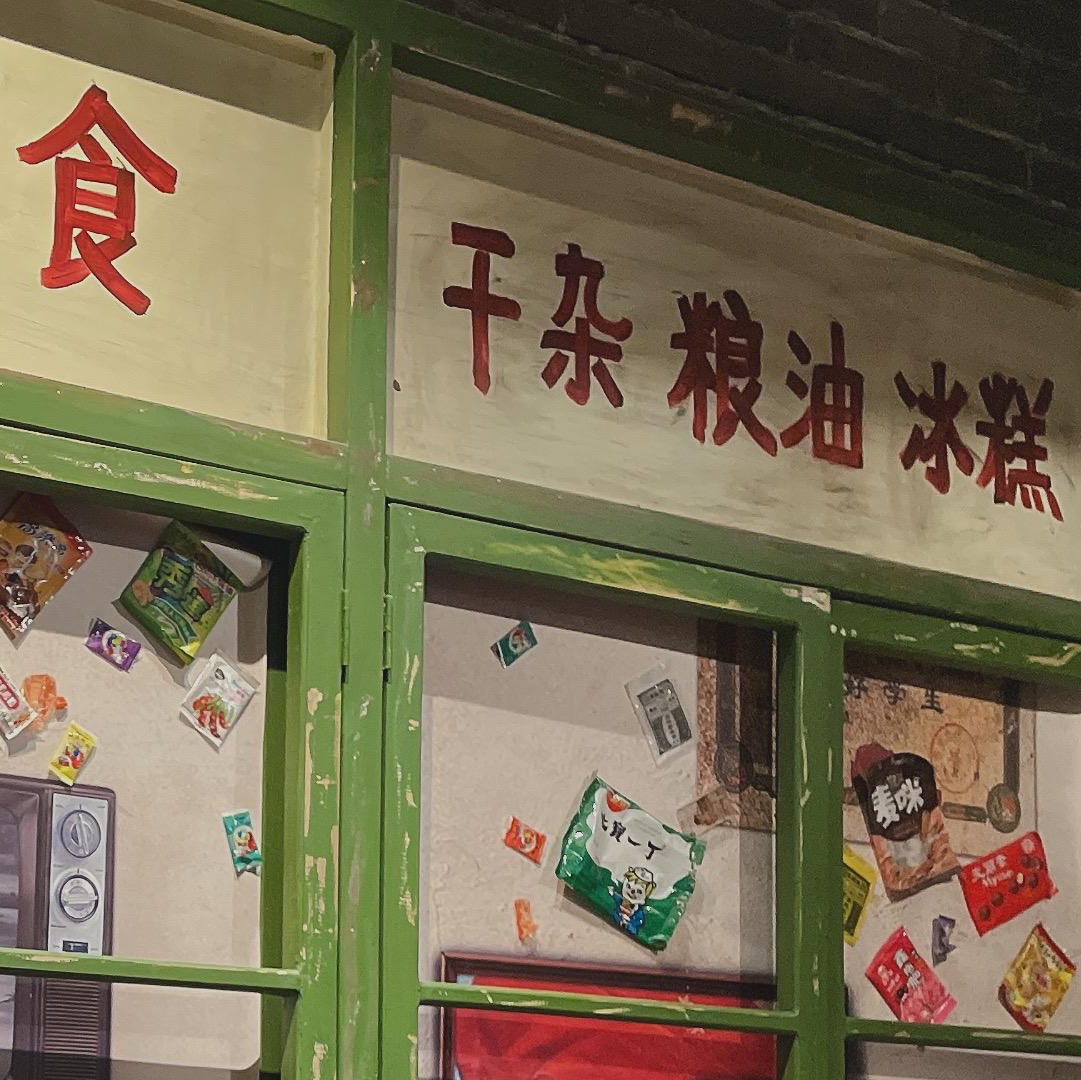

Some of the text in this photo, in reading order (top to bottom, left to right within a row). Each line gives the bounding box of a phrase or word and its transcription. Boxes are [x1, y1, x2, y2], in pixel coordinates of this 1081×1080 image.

[442, 221, 1065, 523] 干杂 粮油 冰糕
